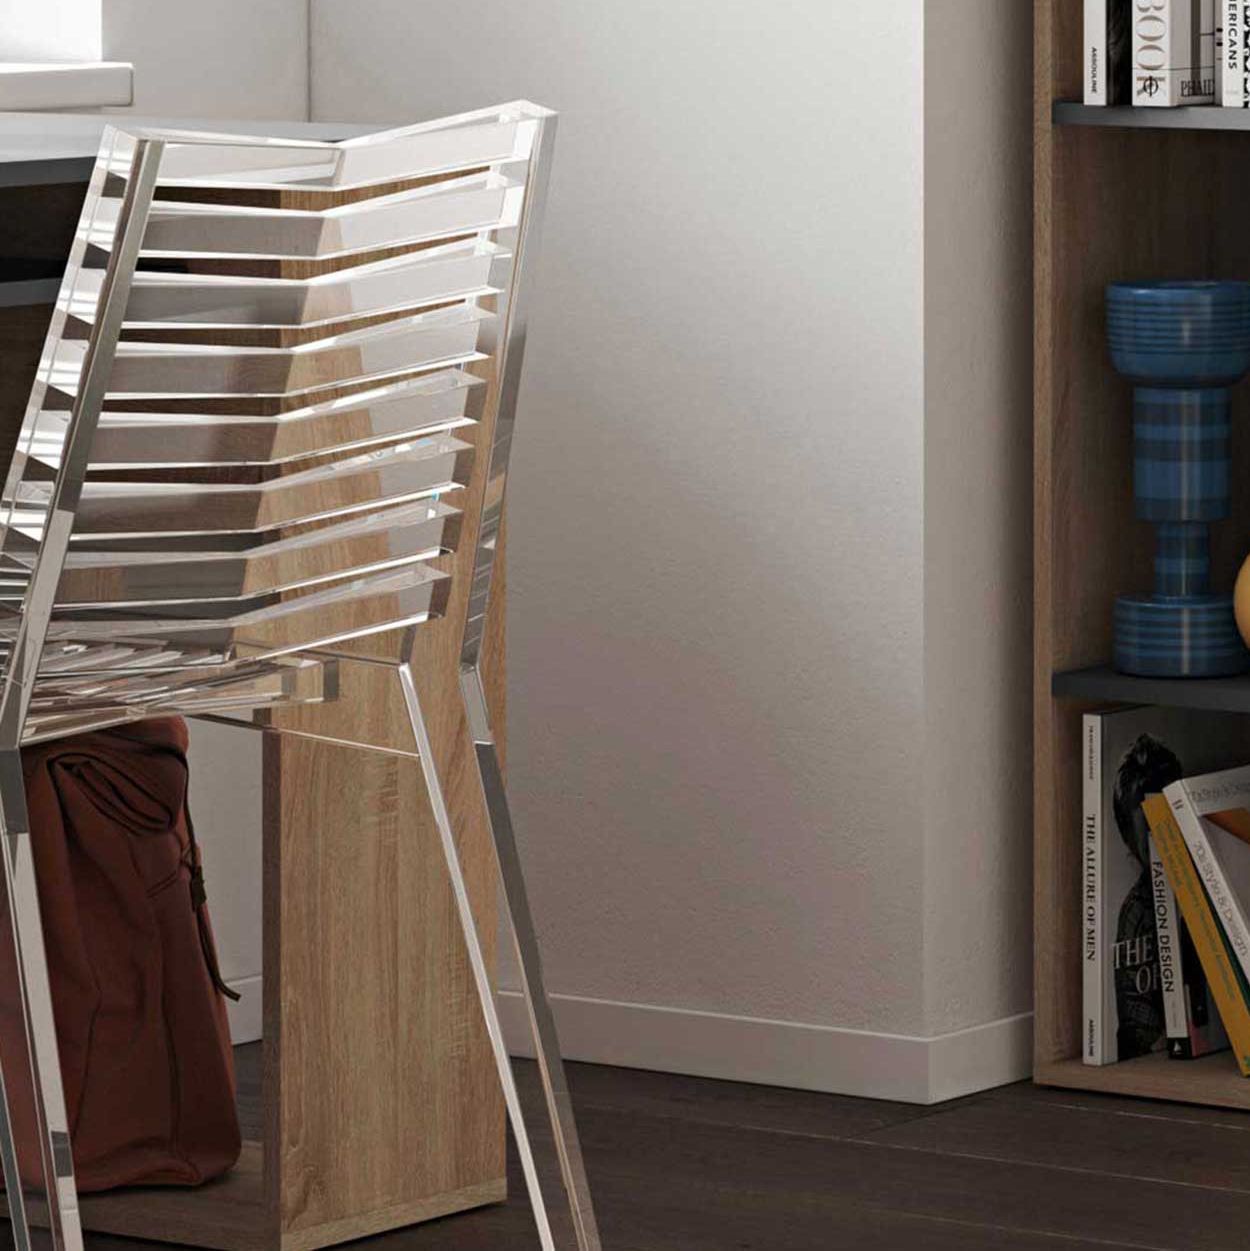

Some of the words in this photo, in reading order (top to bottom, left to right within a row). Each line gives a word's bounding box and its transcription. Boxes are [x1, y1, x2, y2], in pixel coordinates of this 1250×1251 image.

[1086, 814, 1096, 843] THE
[1086, 847, 1096, 903] ALLURE
[1152, 860, 1169, 931] FASHION
[1086, 906, 1096, 925] OF
[1086, 927, 1096, 962] MEN
[1113, 934, 1153, 969] THE
[1159, 935, 1175, 993] DESIGN
